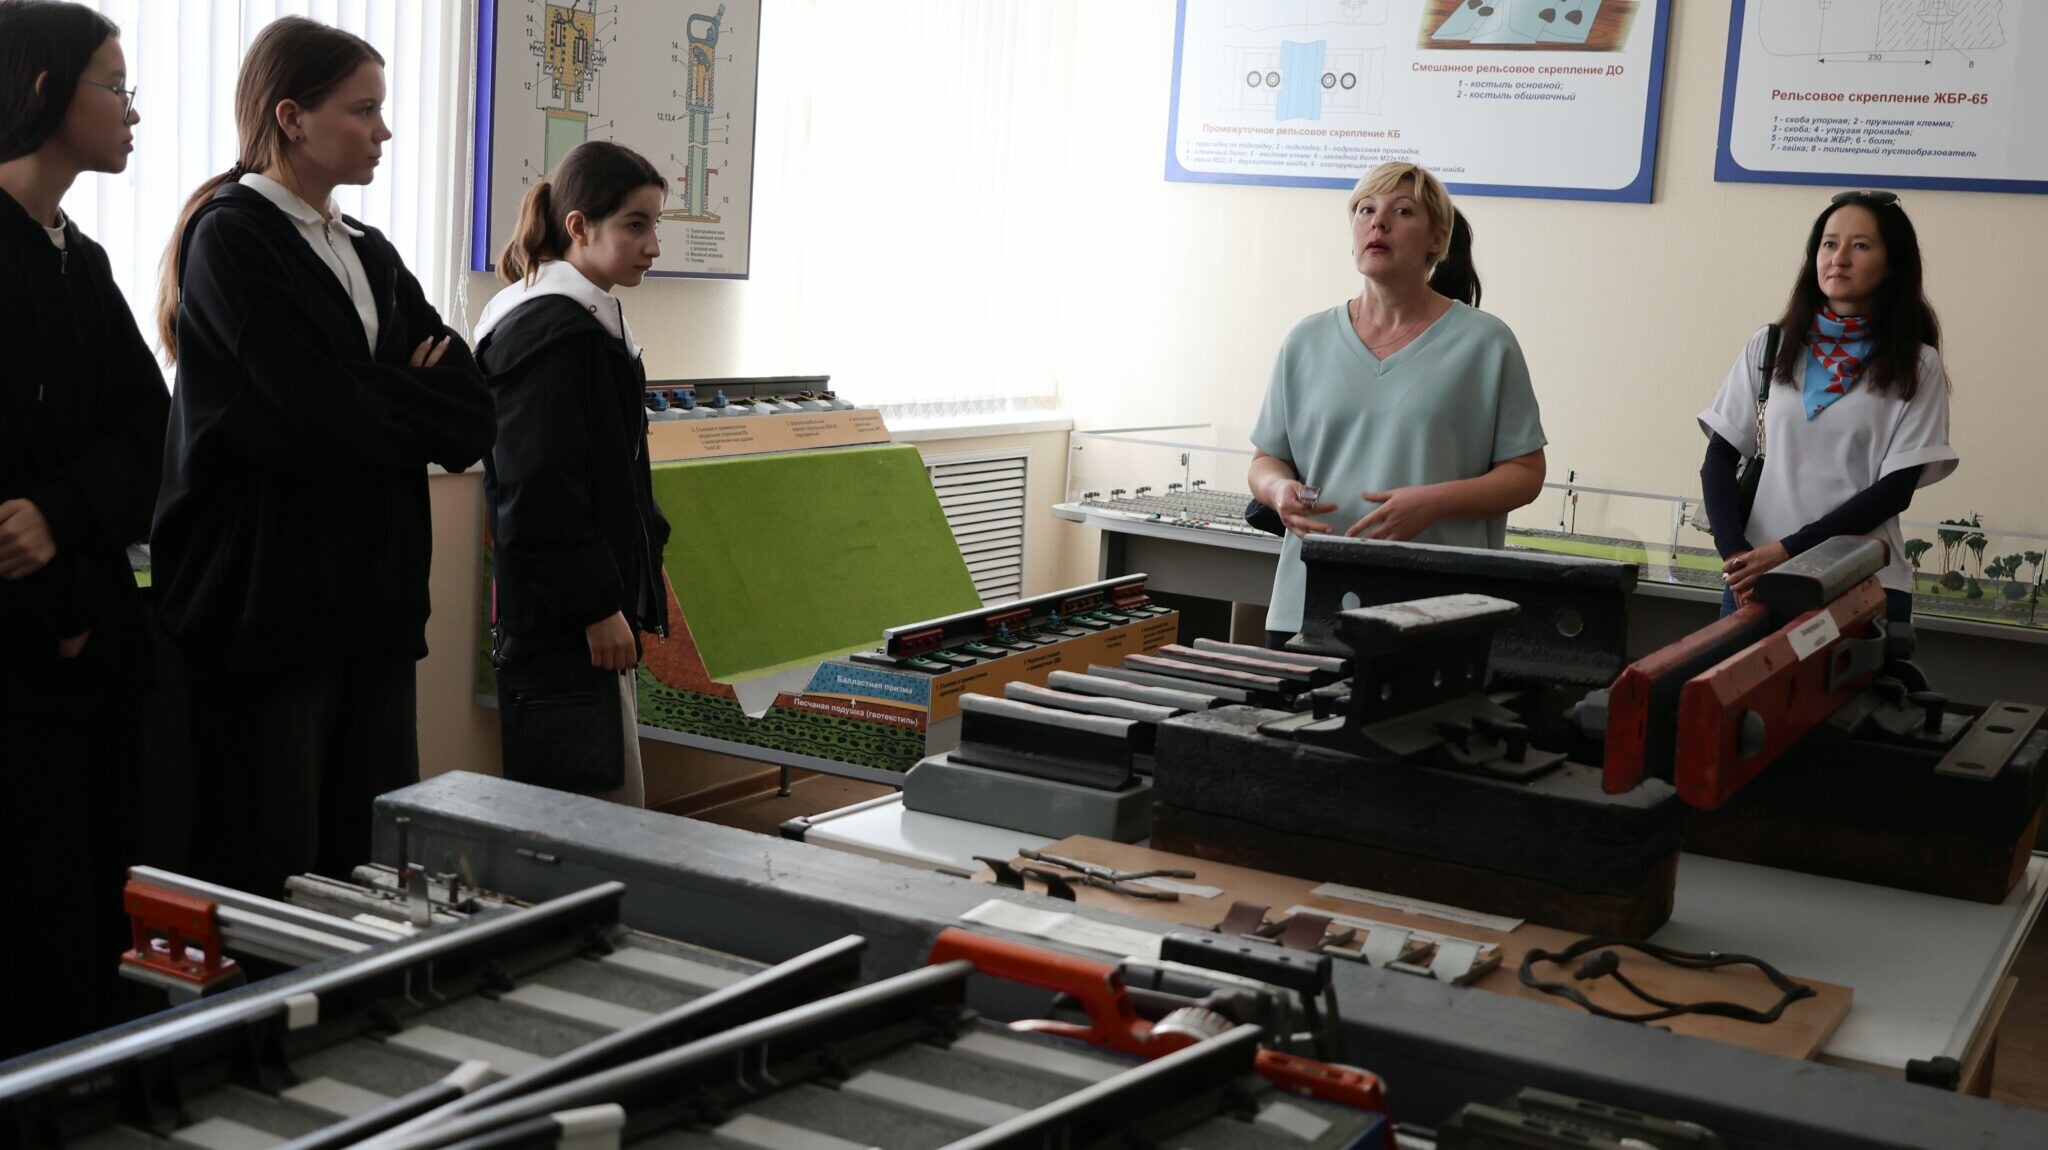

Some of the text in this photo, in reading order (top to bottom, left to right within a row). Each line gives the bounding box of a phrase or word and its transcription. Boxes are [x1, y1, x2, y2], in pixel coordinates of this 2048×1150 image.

[614, 16, 618, 24] 3
[526, 28, 532, 36] 13
[1868, 53, 1882, 61] 230
[1412, 62, 1624, 76] Смешанное рельсовое скрепление ДО
[1968, 60, 1974, 68] 8
[524, 82, 532, 90] 12
[1515, 82, 1564, 90] основной;
[672, 90, 676, 98] 5
[1456, 90, 1462, 98] 2
[1469, 92, 1512, 100] костыль
[1514, 92, 1576, 101] обшивочный
[1772, 89, 1988, 104] Рельсовое скрепление ЖБР-65
[1812, 117, 1851, 126] упорная;
[1853, 117, 1858, 125] 2
[1866, 119, 1915, 127] пружинная
[1916, 120, 1954, 128] клемма;
[1203, 123, 1401, 139] Промежуточное рельсовое скрепление КБ
[1784, 126, 1811, 134] скоба;
[1826, 127, 1861, 136] упругая
[1863, 128, 1912, 137] прокладка;
[1784, 135, 1828, 144] прокладка
[1830, 136, 1854, 144] ЖБР;
[1868, 137, 1896, 146] болт;
[1770, 143, 1776, 151] 7
[1782, 144, 1808, 153] гайка;
[1823, 146, 1880, 155] полимерный
[1882, 147, 1976, 158] пустообразователь
[524, 158, 528, 167] 9
[837, 675, 913, 695] Балластная призма
[794, 698, 918, 727] Песчаная подушка (геотекстиль)
